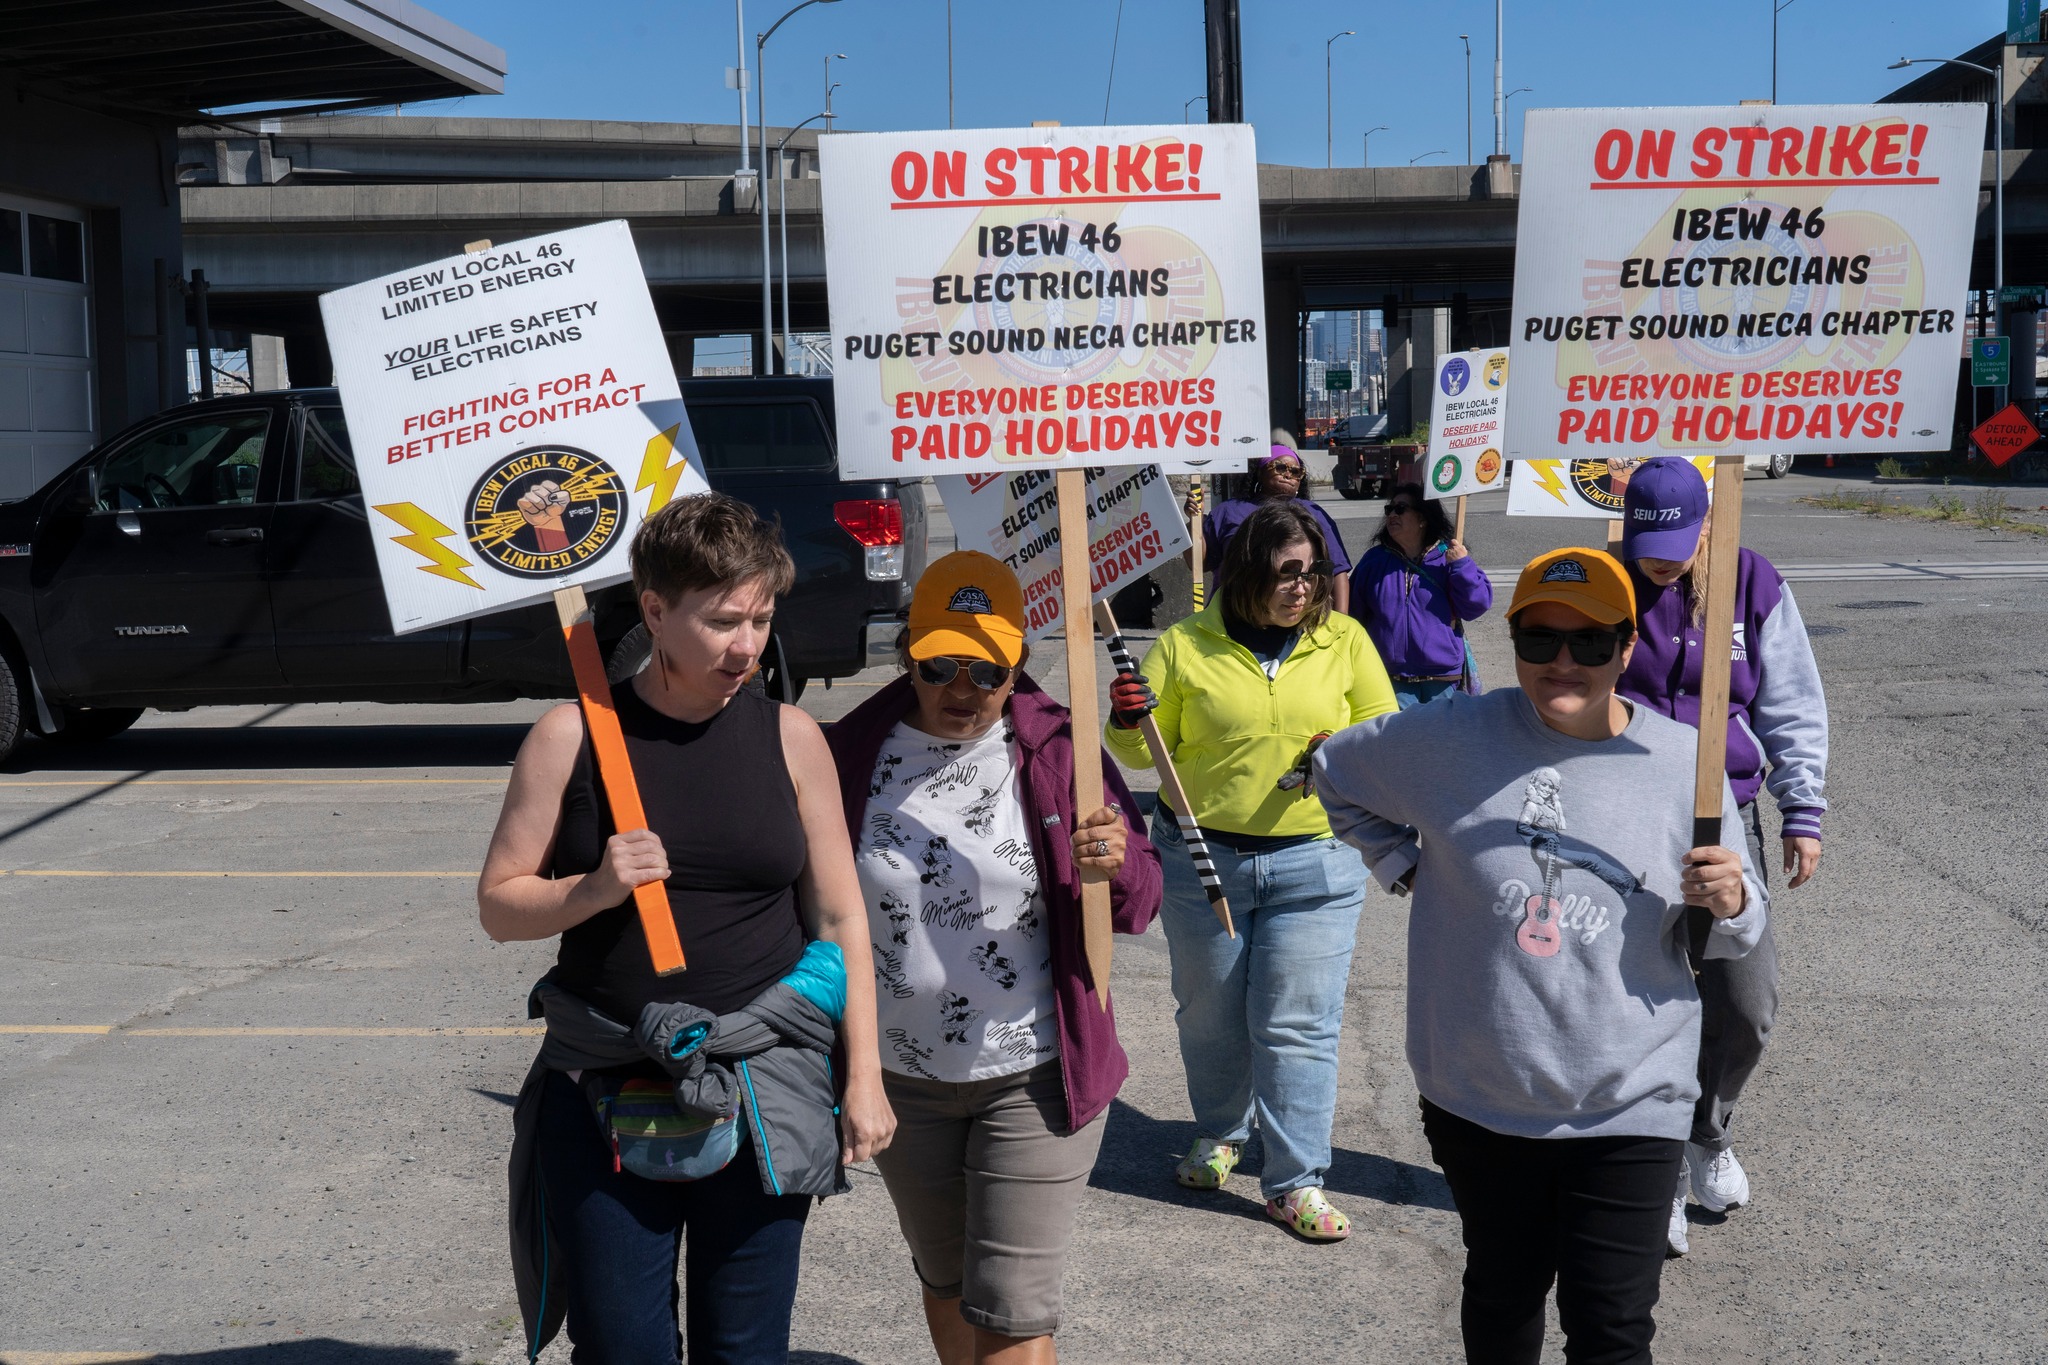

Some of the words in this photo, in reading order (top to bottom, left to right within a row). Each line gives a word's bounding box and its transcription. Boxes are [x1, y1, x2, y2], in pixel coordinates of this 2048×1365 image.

[1593, 128, 1676, 181] ON
[1690, 123, 1929, 179] STRIKE!
[891, 149, 967, 201] ON
[984, 142, 1203, 198] STRIKE!
[977, 222, 1070, 259] IBEW
[1079, 221, 1122, 254] 46
[1672, 206, 1772, 242] IBEW
[1779, 205, 1826, 240] 46
[386, 269, 444, 299] IBEW
[451, 250, 531, 281] LOCAL
[536, 242, 562, 260] 46
[932, 267, 1169, 306] ELECTRICIANS
[1619, 254, 1871, 289] ELECTRICIANS
[381, 283, 474, 321] LIMITED
[480, 258, 576, 294] ENERGY
[384, 337, 450, 368] YOUR
[454, 323, 506, 349] LIFE
[509, 300, 598, 334] SAFETY
[844, 331, 943, 361] PUGET
[948, 326, 1046, 357] SOUND
[1053, 323, 1125, 352] NECA
[1131, 318, 1257, 348] CHAPTER
[1524, 315, 1623, 342] PUGET
[1629, 312, 1729, 341] SOUND
[1737, 311, 1813, 338] NECA
[1821, 309, 1955, 336] CHAPTER
[411, 325, 583, 382] ELECTRICIANS
[1987, 346, 1995, 356] 5
[403, 387, 529, 436] FIGHTING
[537, 372, 591, 401] FOR
[599, 367, 617, 387] A
[895, 384, 1058, 419] EVERYONE
[1065, 378, 1216, 411] DESERVES
[1566, 371, 1734, 403] EVERYONE
[1740, 368, 1902, 399] DESERVES
[1445, 402, 1465, 412] IBEW
[1466, 398, 1489, 409] LOCAL
[1445, 407, 1497, 421] ELECTRICIANS
[1556, 405, 1660, 445] PAID
[1671, 401, 1905, 444] HOLIDAYS!
[387, 420, 491, 465] BETTER
[498, 383, 646, 434] CONTRACT
[890, 421, 992, 463] PAID
[1004, 409, 1223, 457] HOLIDAYS!
[1443, 423, 1479, 437] DESERVE
[1479, 420, 1498, 431] PAID
[1449, 434, 1490, 449] HOLIDAYS!
[1985, 424, 2028, 435] DETOUR
[1985, 436, 2023, 447] AHEAD
[476, 479, 504, 512] IBEW
[500, 453, 551, 482] LOCAL
[557, 454, 579, 471] 46
[1009, 468, 1051, 500] IBEW
[1096, 463, 1160, 514] CHAPTER
[1633, 507, 1656, 521] SEIU
[1659, 506, 1681, 520] 775
[500, 546, 572, 570] LIMITED
[573, 507, 617, 559] ENERGY
[1019, 527, 1060, 564] SOUND
[1089, 511, 1152, 563] ESERVES
[1090, 529, 1164, 594] LIDAYS!
[959, 591, 984, 601] CASA
[115, 624, 189, 636] TUNDRA
[872, 813, 906, 848] Minnie
[871, 838, 901, 870] Mouse
[920, 890, 974, 927] Minnie
[950, 904, 997, 931] Mouse
[886, 1028, 933, 1061] Minnie
[986, 1020, 1039, 1050] Minnie
[1007, 1037, 1054, 1061] Mouse
[899, 1052, 941, 1082] Mouse
